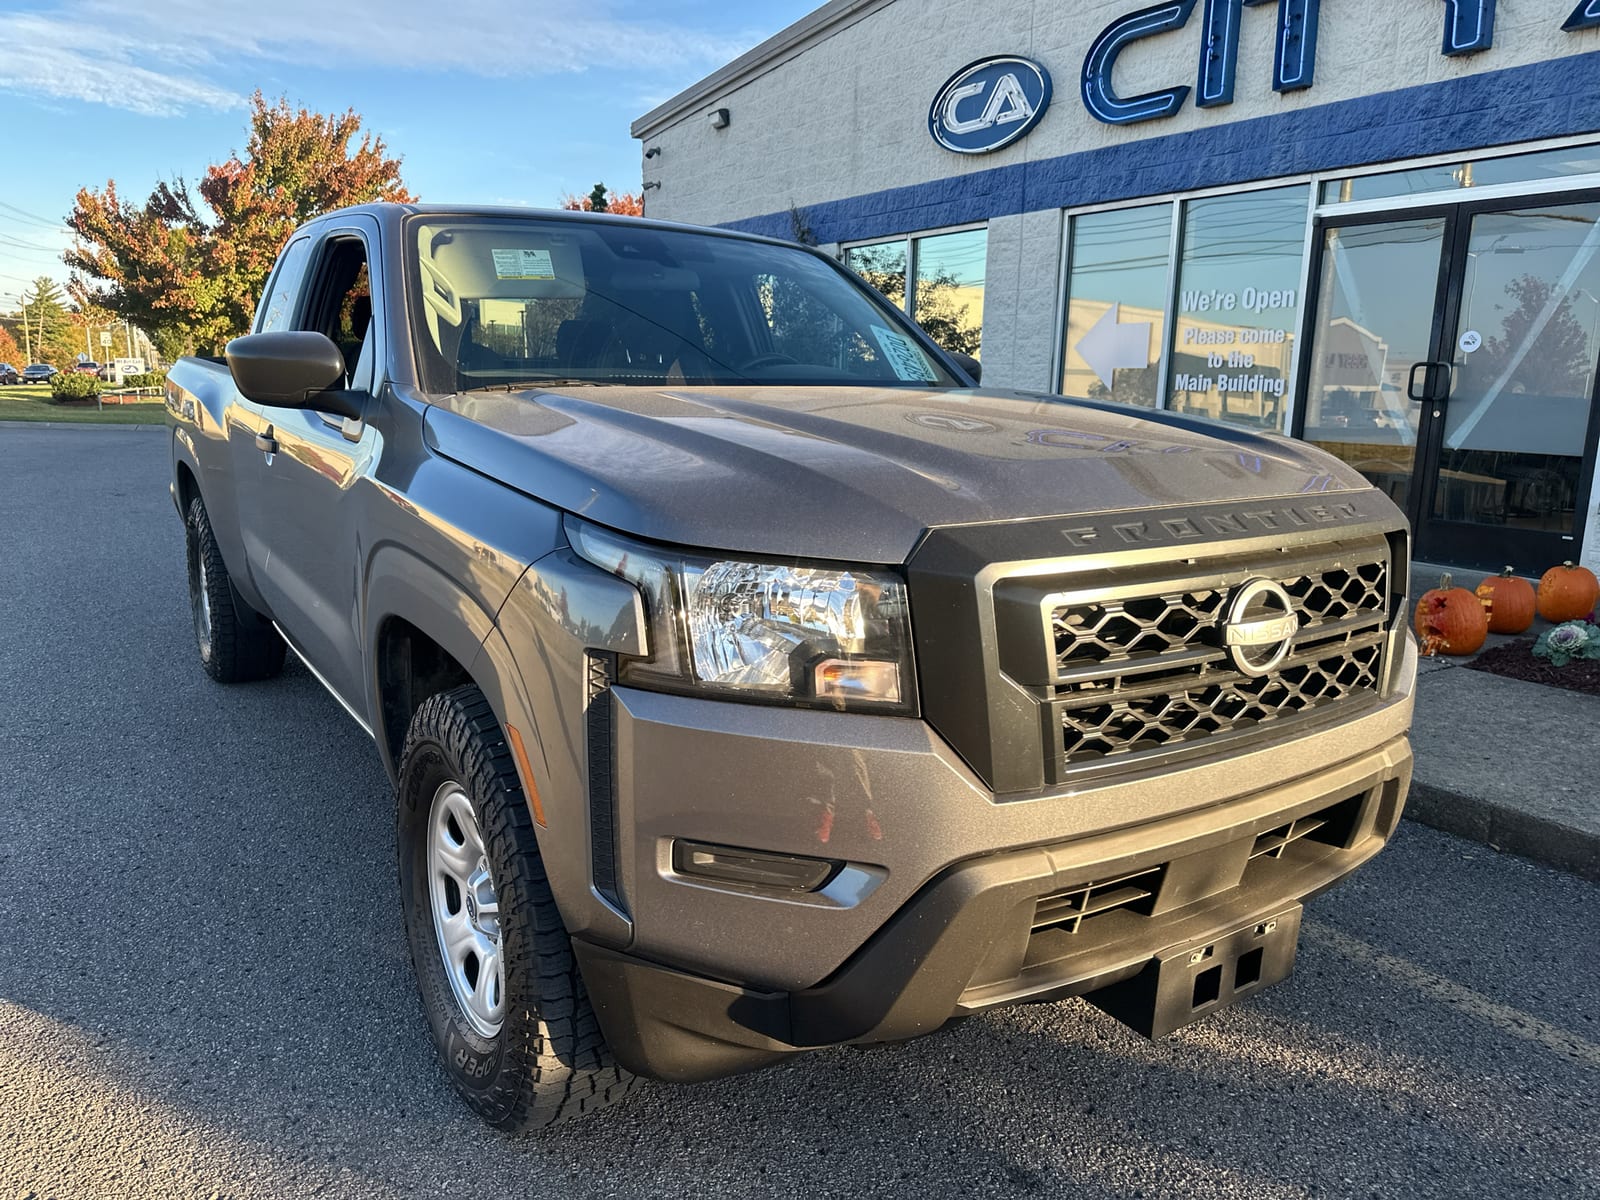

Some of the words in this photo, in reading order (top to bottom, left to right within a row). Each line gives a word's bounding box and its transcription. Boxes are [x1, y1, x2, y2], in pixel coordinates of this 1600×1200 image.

[942, 73, 1034, 134] CA
[1181, 289, 1236, 312] We're
[1241, 287, 1296, 314] Open
[1183, 327, 1235, 344] Please
[1240, 328, 1286, 343] come
[1207, 352, 1223, 368] to
[1228, 351, 1254, 368] the
[1175, 374, 1213, 391] Main
[1217, 374, 1286, 396] Building
[1061, 502, 1367, 547] FRONTIER
[1229, 617, 1297, 642] NISSAN
